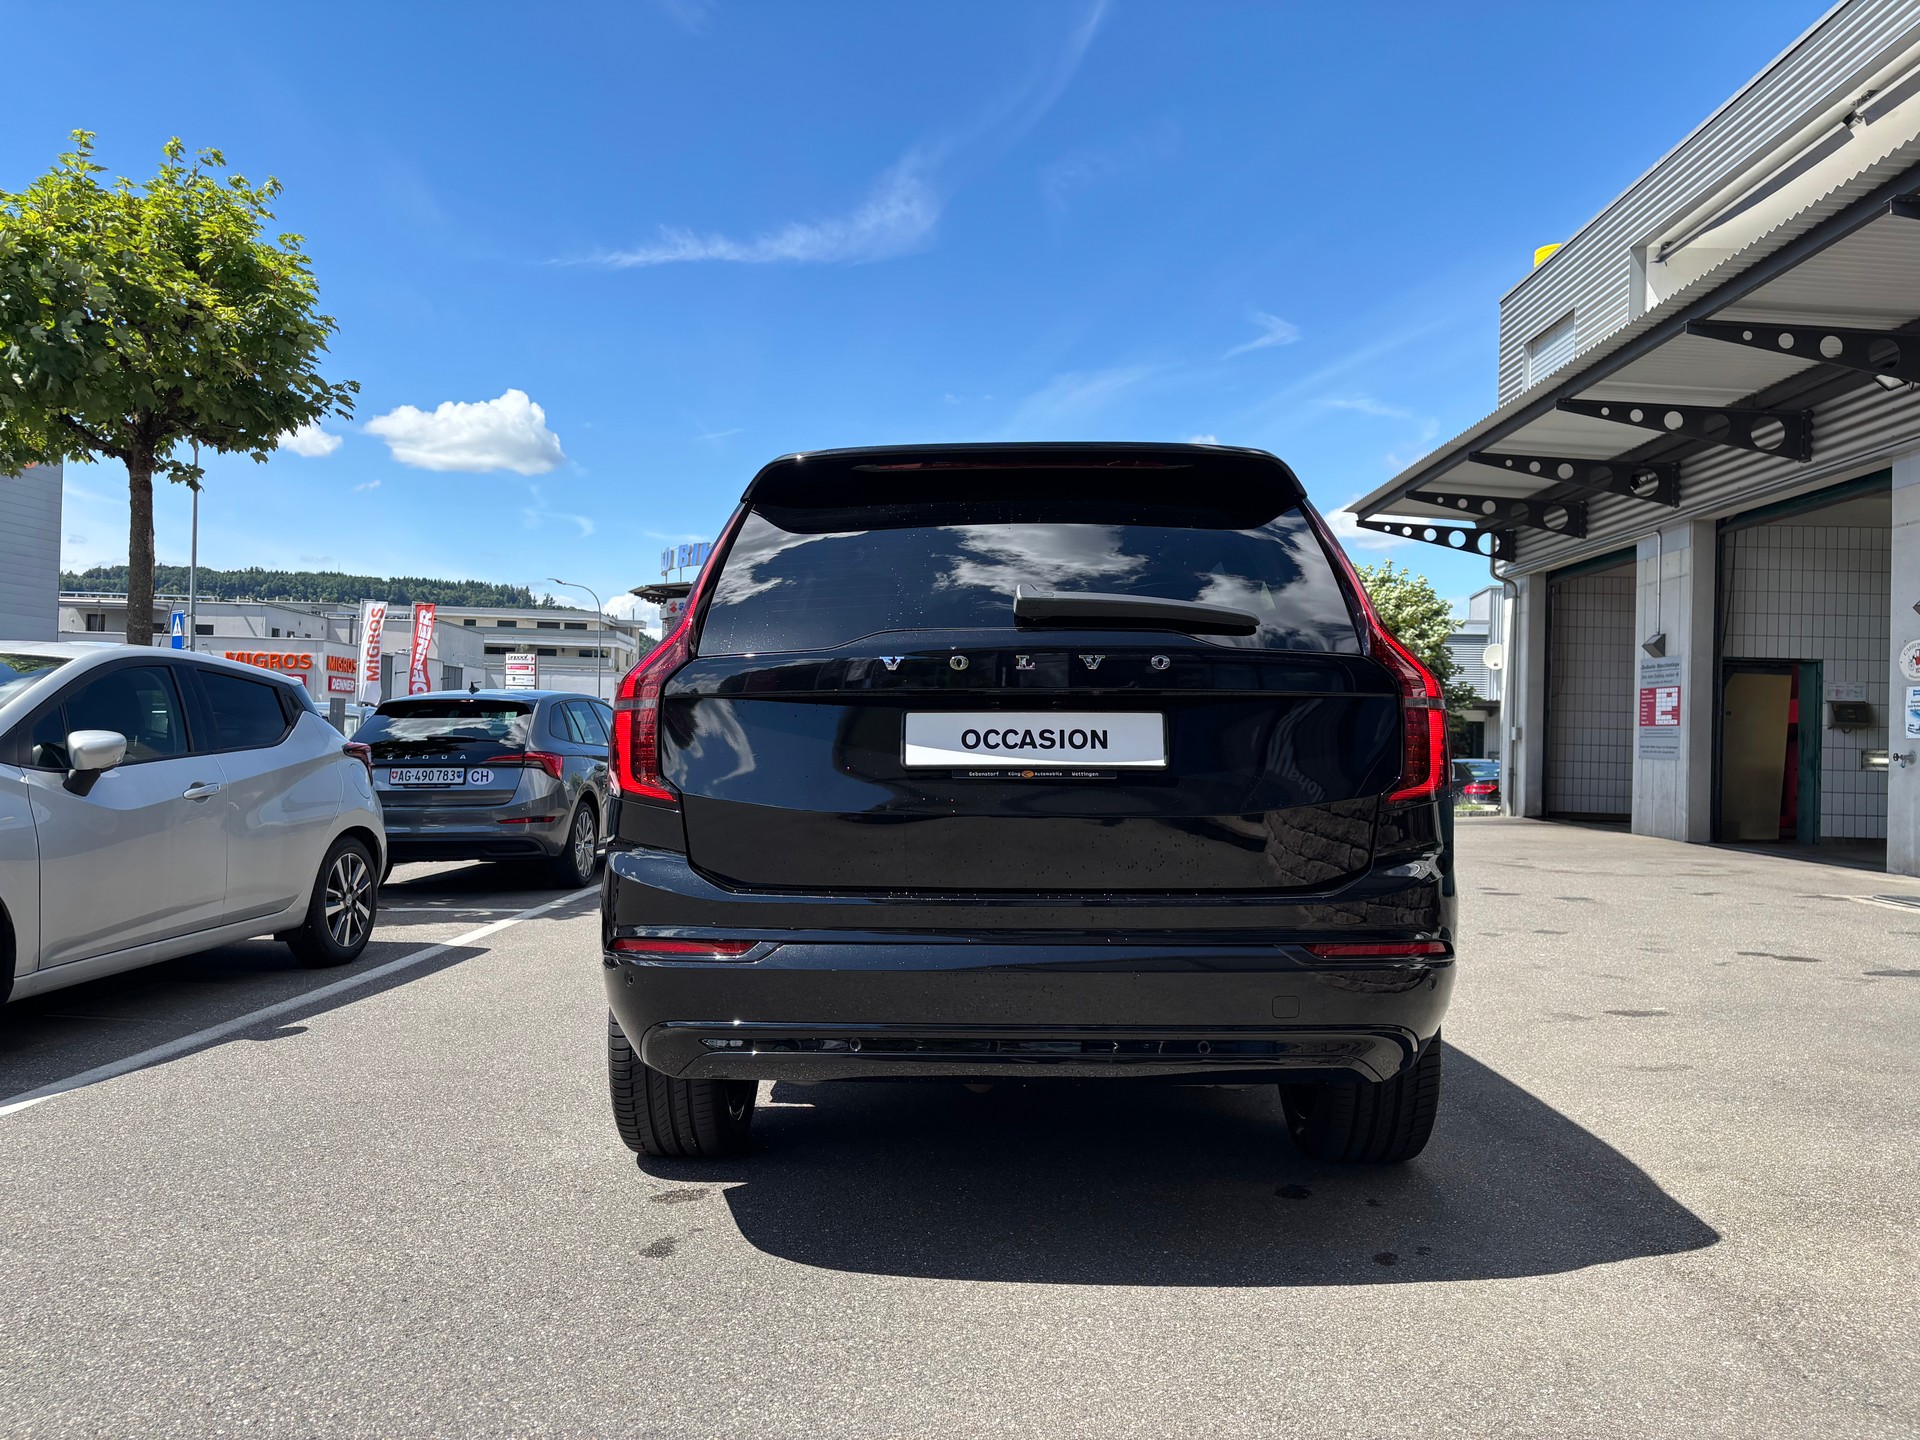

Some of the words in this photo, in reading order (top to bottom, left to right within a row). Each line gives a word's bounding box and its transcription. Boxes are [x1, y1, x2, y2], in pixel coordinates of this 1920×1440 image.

[366, 607, 385, 681] MIGROS
[411, 609, 433, 694] DENNER
[327, 655, 357, 673] MIGROS
[879, 655, 1172, 671] VOLVO
[331, 677, 355, 691] DENNER
[961, 729, 1109, 750] OCCASION
[471, 770, 489, 783] CH
